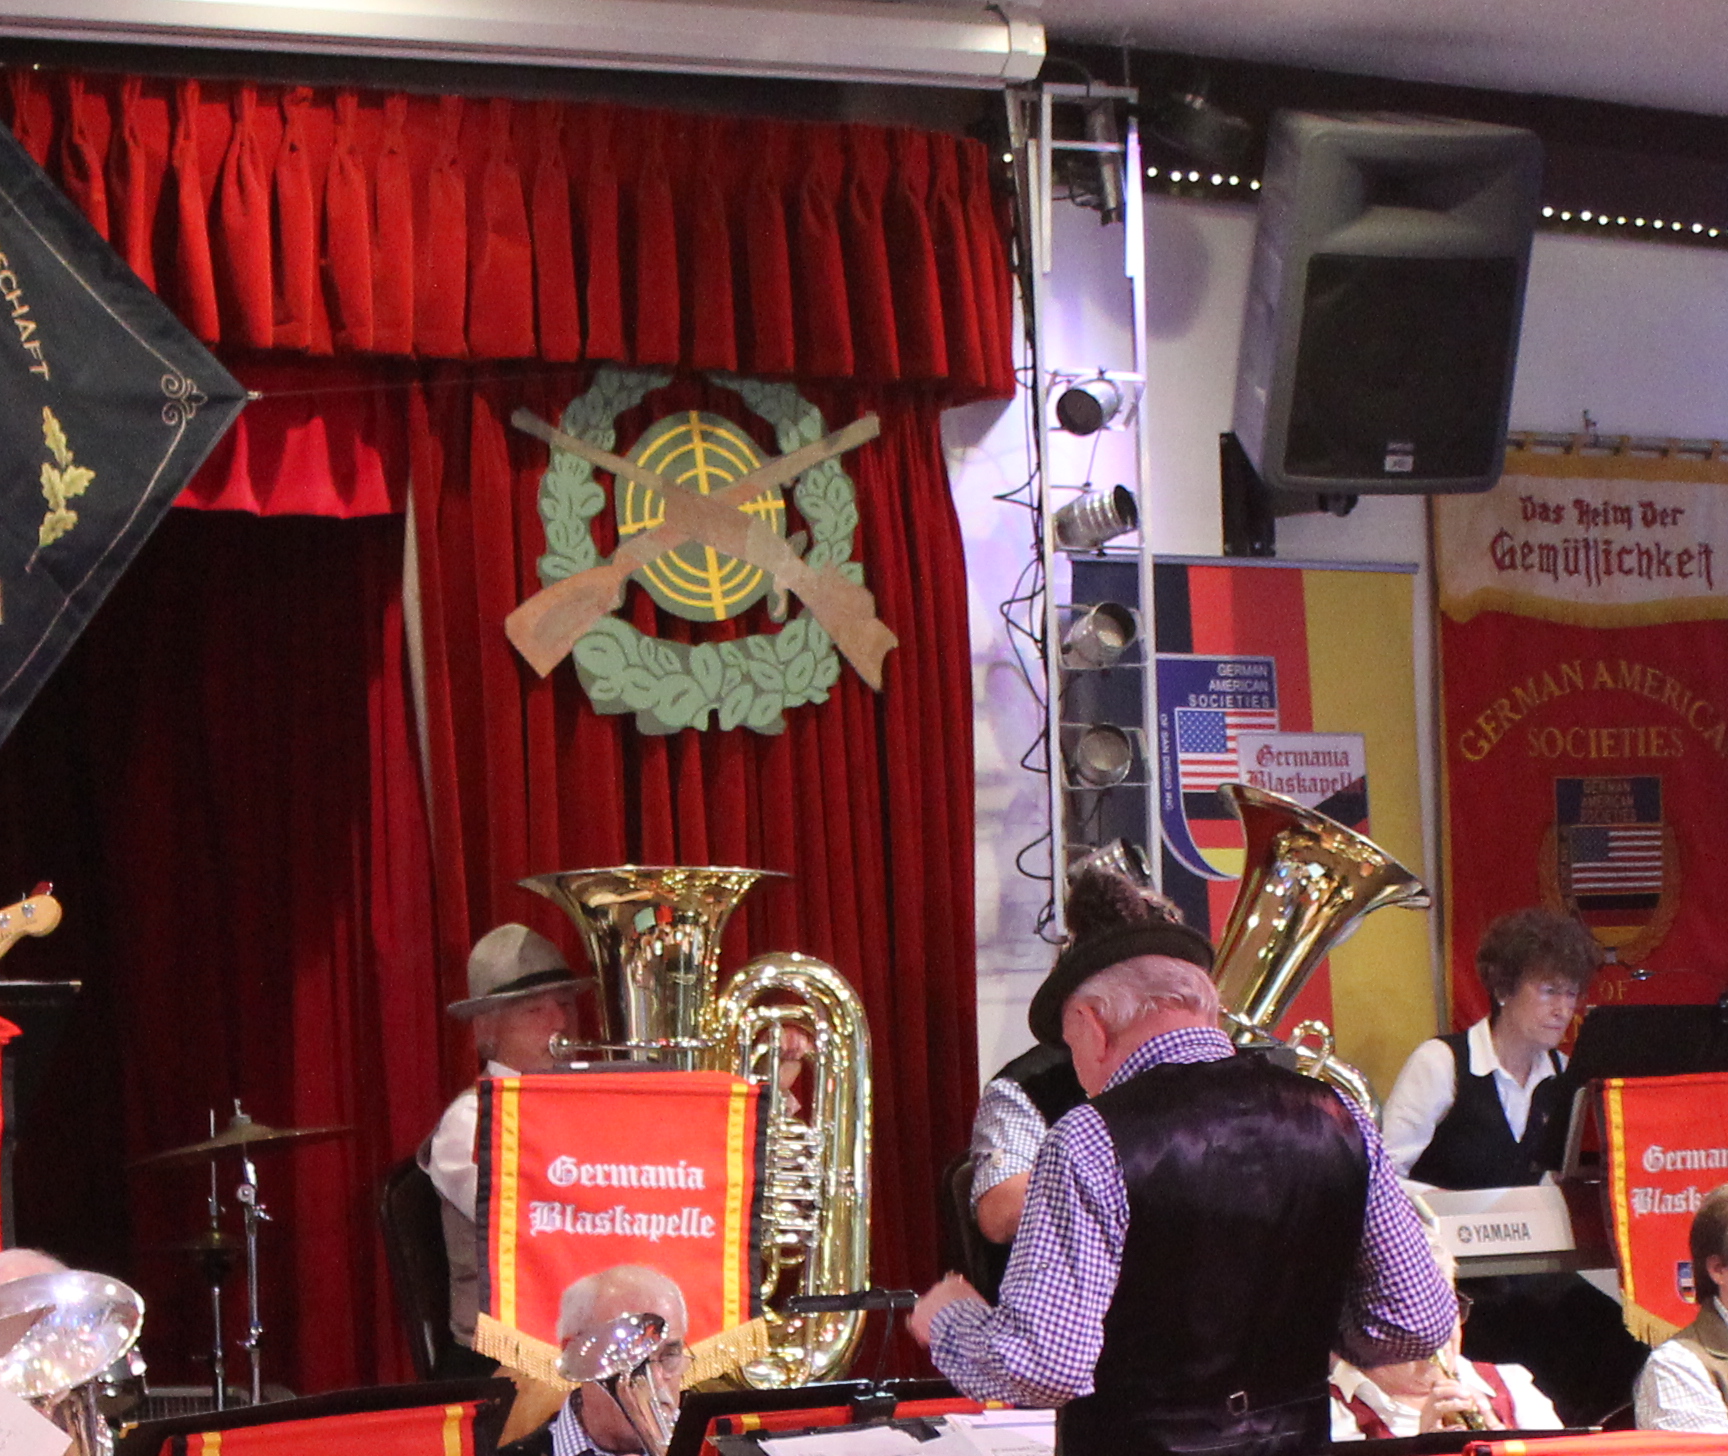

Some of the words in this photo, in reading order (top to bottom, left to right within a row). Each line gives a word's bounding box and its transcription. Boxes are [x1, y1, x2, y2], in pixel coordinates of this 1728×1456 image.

[1519, 495, 1565, 525] Das
[1573, 498, 1632, 532] Heim
[1491, 527, 1713, 590] Gemütlichkeit
[1209, 679, 1269, 692] AMERICAN
[1217, 664, 1268, 677] GERMAN
[1188, 694, 1271, 708] SOCIETIES
[1459, 660, 1585, 761] GERMAN
[1256, 744, 1349, 767] Germania
[1527, 726, 1684, 758] SOCIETIES
[547, 1155, 706, 1190] Germania
[528, 1200, 716, 1243] Blaskapelle
[1475, 1222, 1532, 1243] YAMAHA
